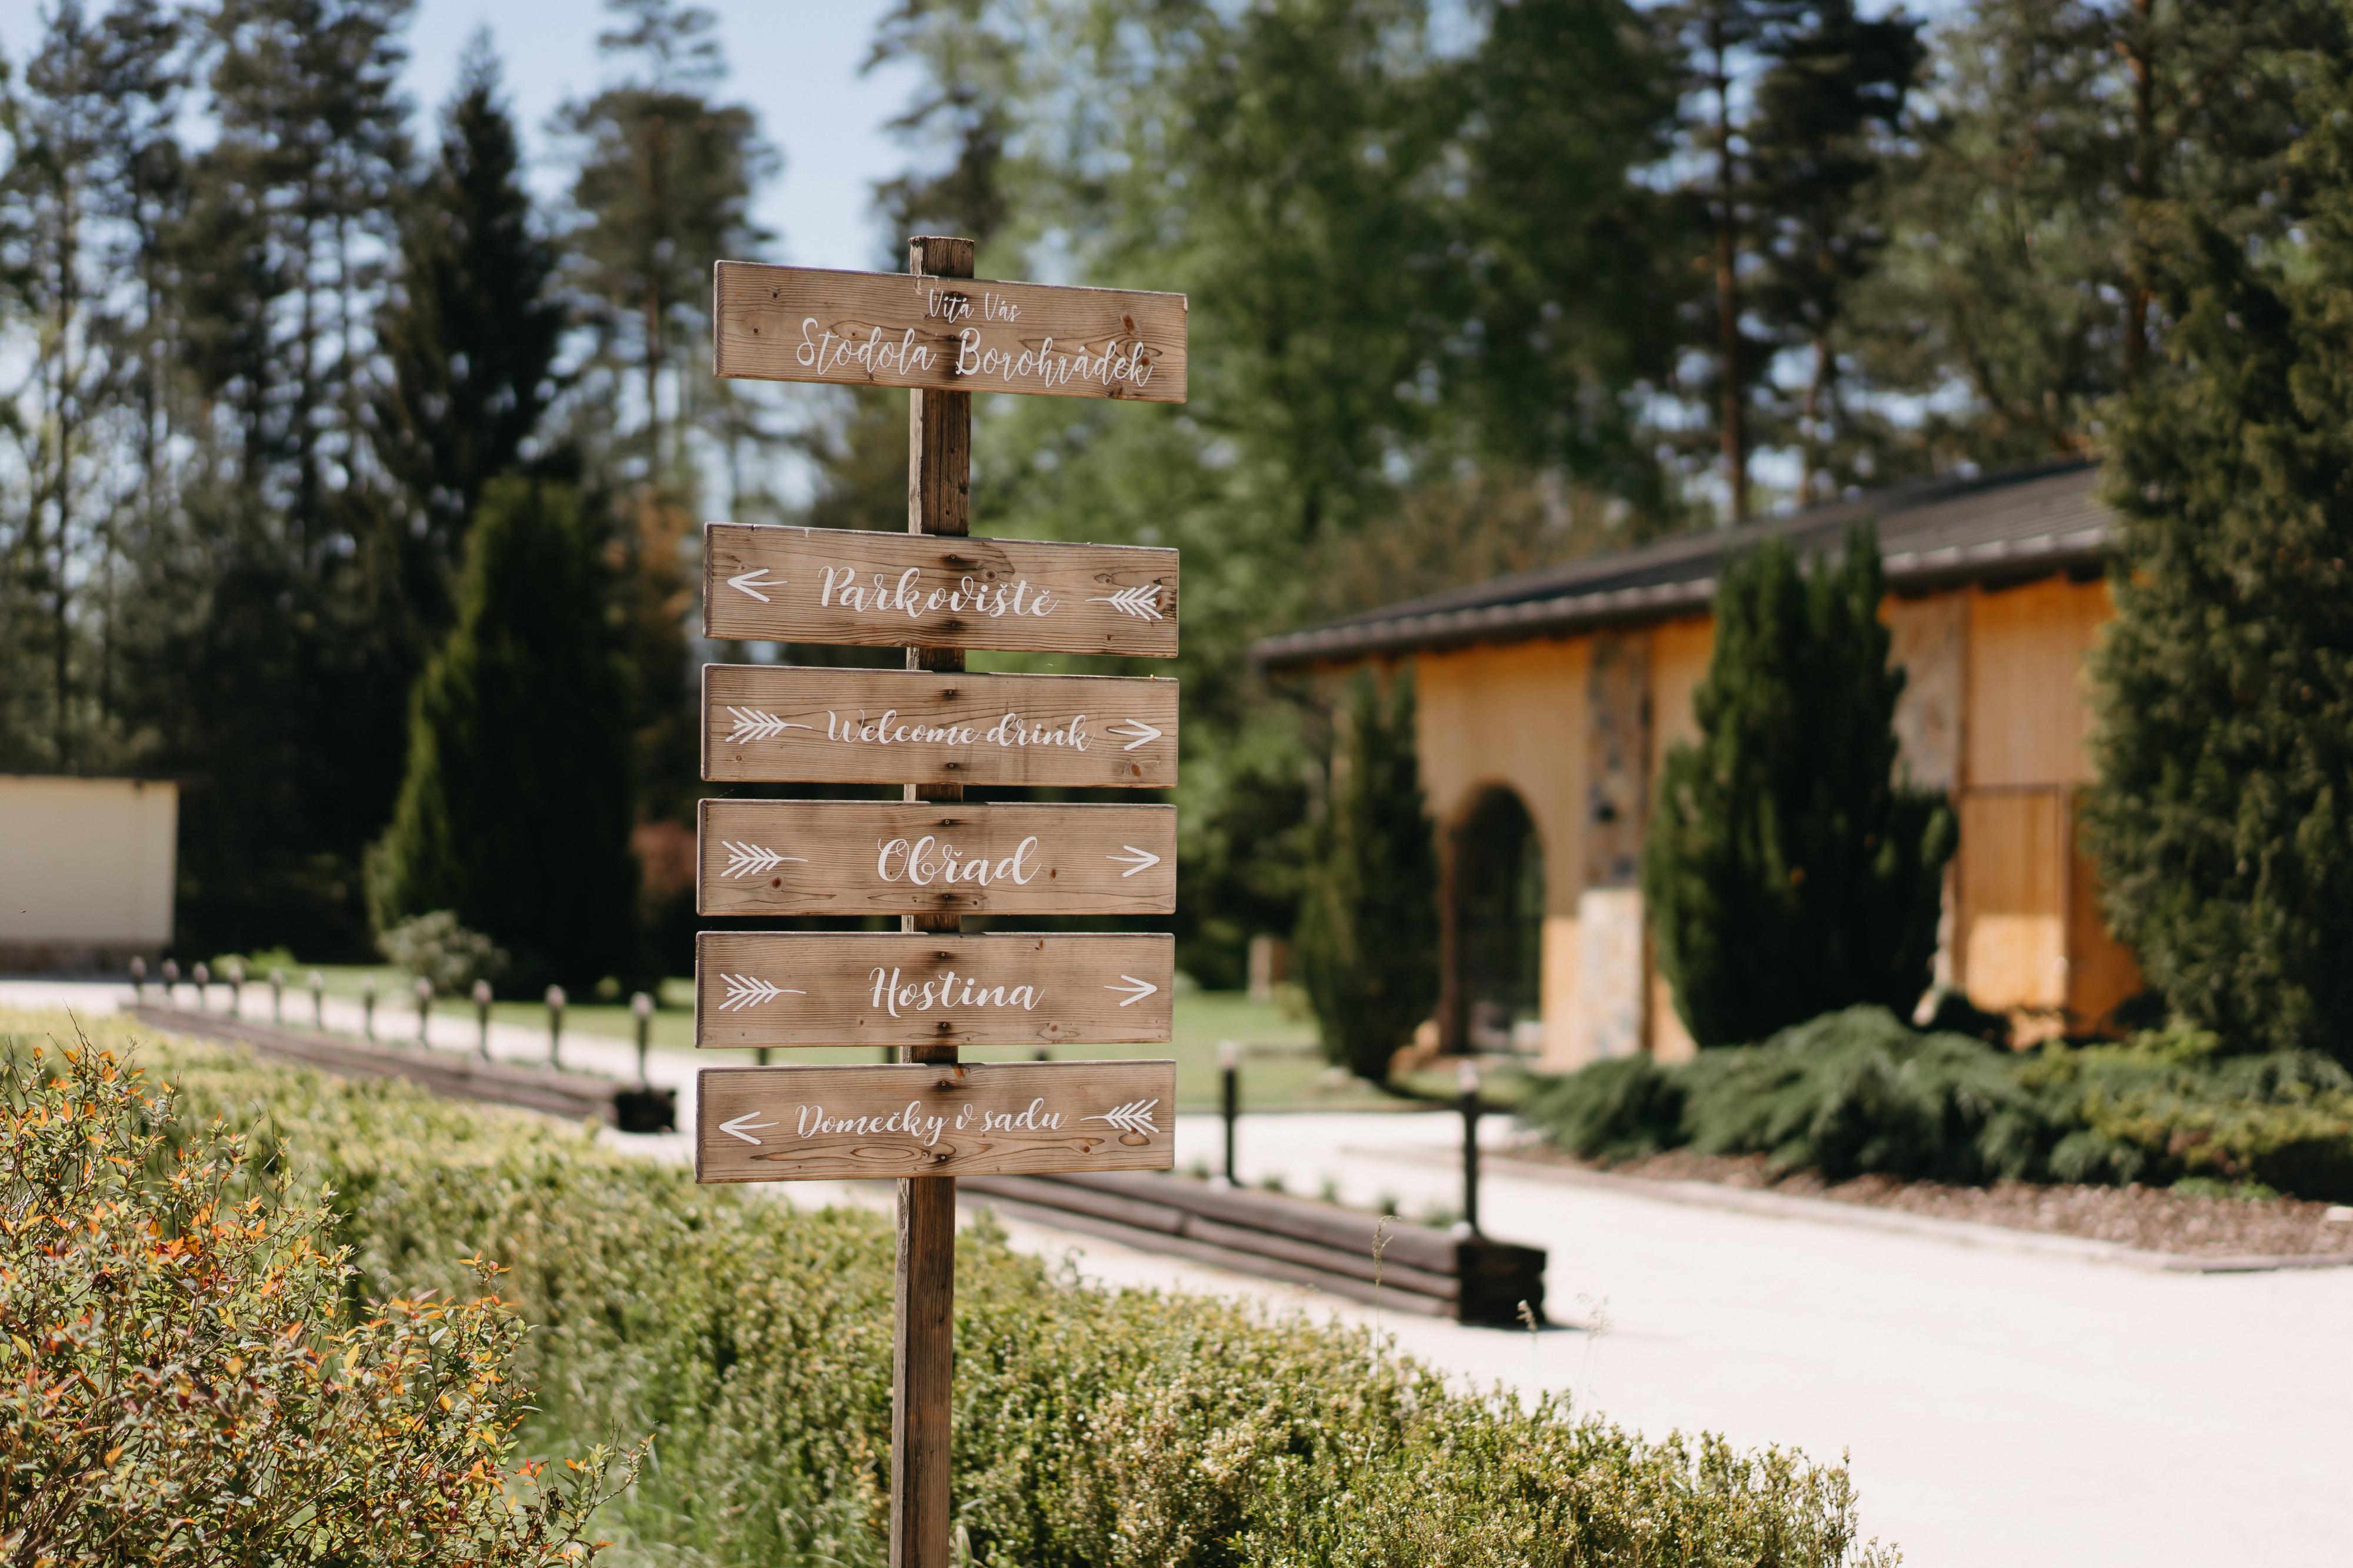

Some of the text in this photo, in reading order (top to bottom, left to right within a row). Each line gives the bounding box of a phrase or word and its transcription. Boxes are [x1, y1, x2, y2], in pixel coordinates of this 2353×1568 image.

[985, 292, 1021, 322] Vás
[796, 318, 1153, 388] Stodola Borohrádek
[818, 566, 1059, 618] Parkoviště
[827, 709, 1095, 752] Welcome drink
[877, 836, 1041, 885] Obřad
[869, 967, 1044, 1017] Hostina
[795, 1097, 1068, 1146] Domečky v sadu
